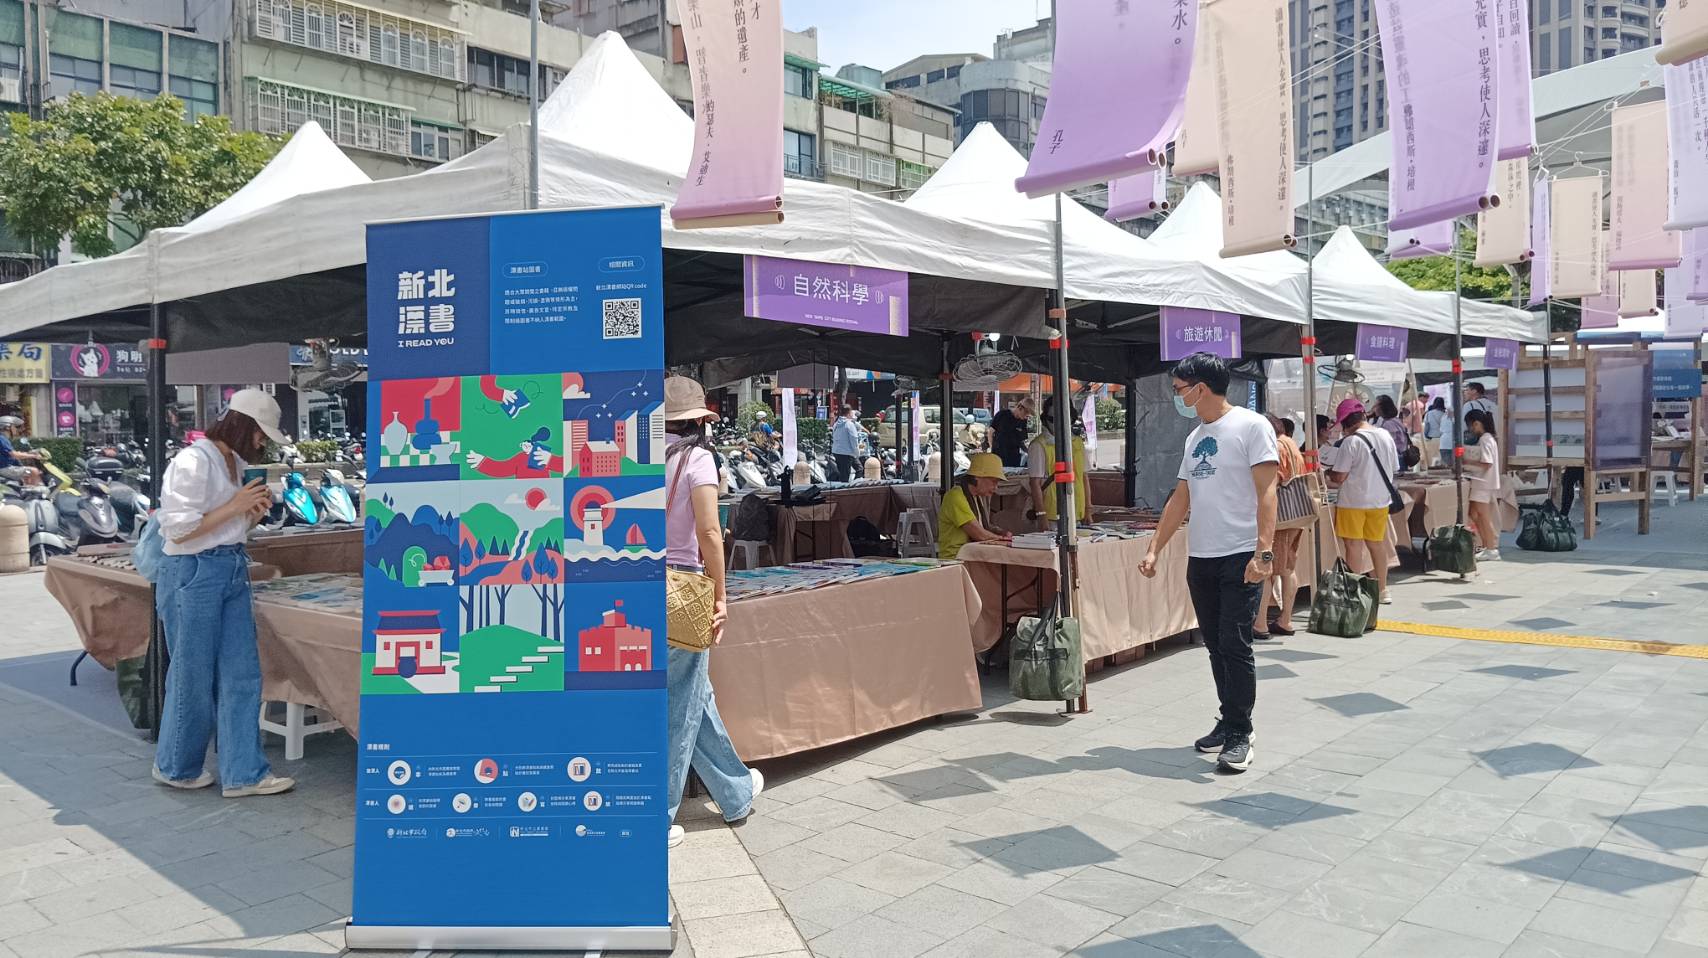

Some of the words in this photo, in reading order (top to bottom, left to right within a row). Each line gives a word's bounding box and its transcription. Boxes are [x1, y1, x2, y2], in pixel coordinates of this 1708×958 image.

[1050, 129, 1064, 155] 孔子
[397, 268, 456, 300] 新北
[793, 273, 870, 306] 自然科學
[398, 340, 404, 348] I
[405, 339, 433, 348] READ
[434, 337, 455, 346] YOU
